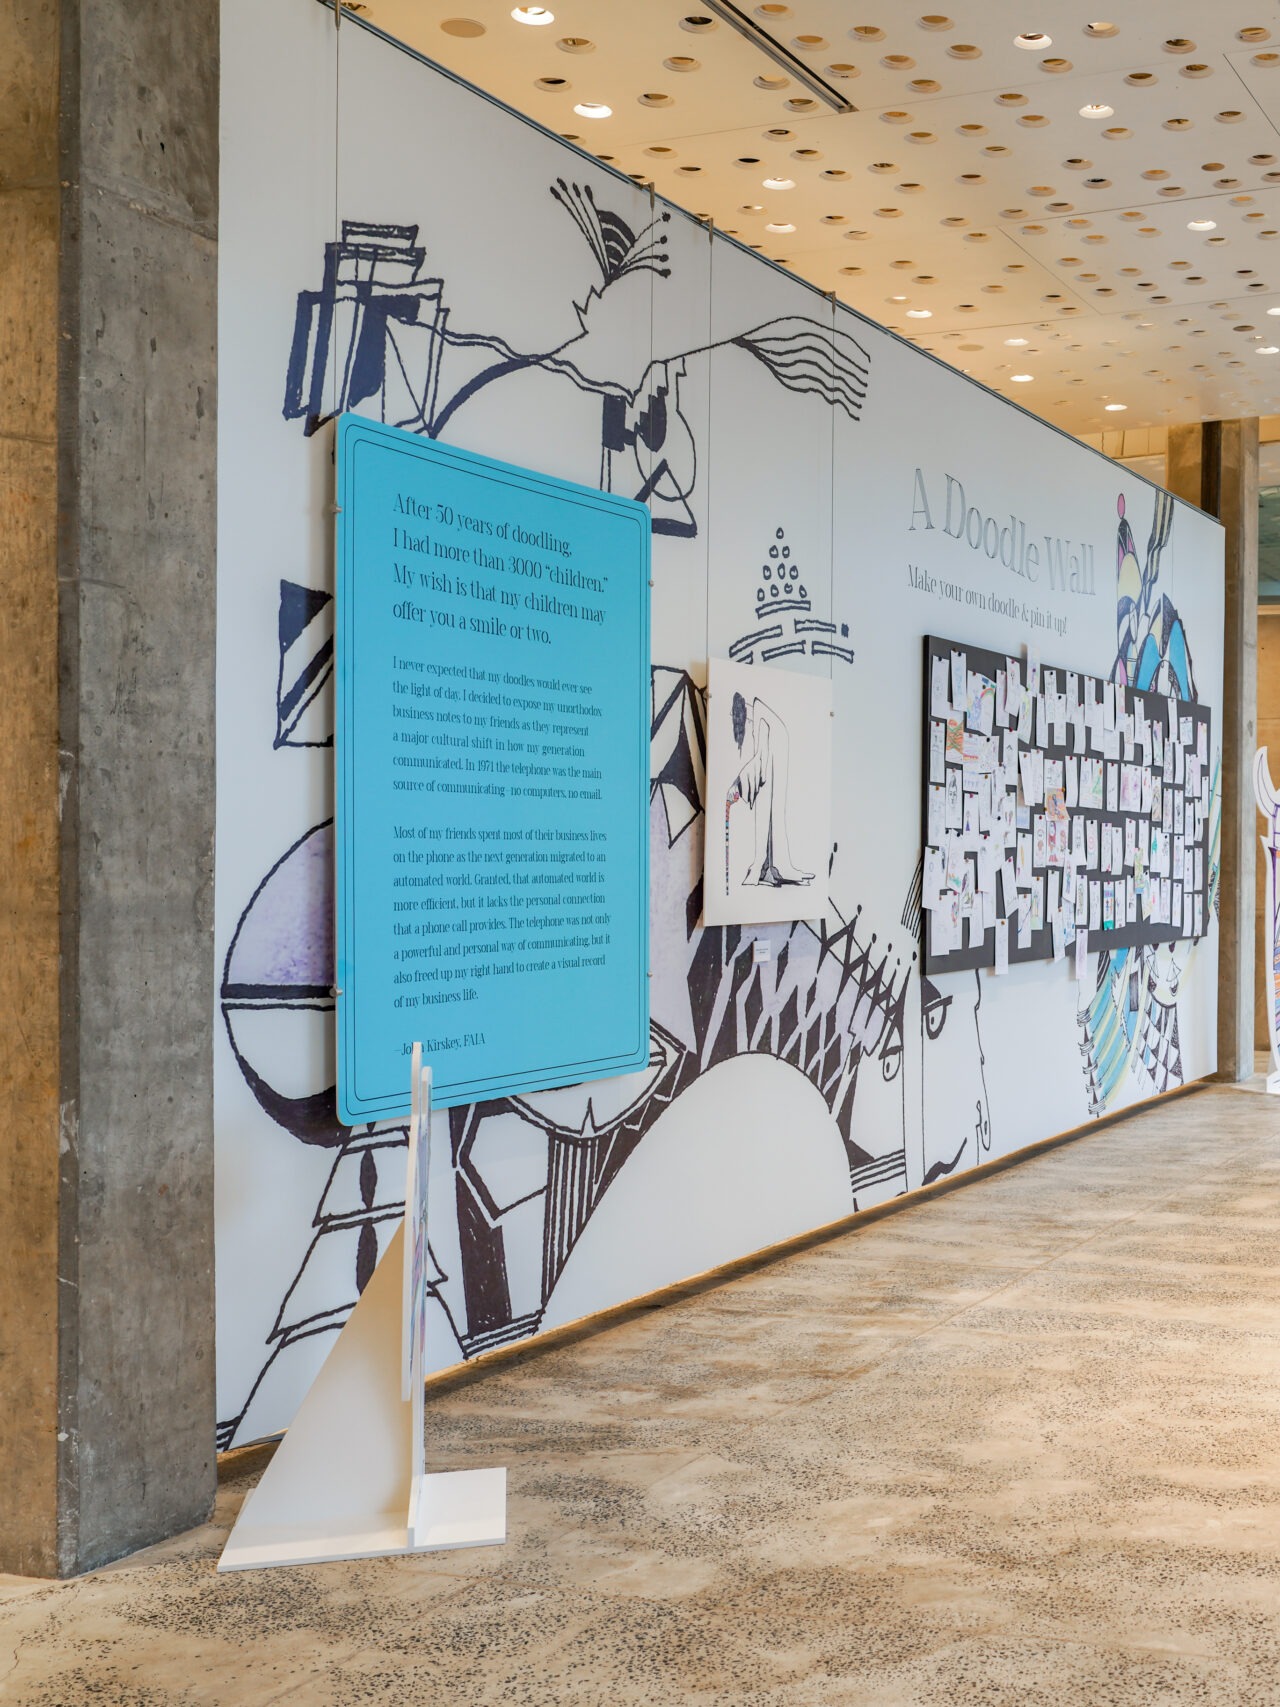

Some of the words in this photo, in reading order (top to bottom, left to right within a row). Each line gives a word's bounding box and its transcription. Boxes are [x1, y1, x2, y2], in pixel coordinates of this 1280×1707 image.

[393, 493, 433, 520] After
[436, 504, 454, 526] 50
[457, 514, 493, 536] years
[496, 522, 511, 540] of
[512, 525, 572, 558] doodling,
[908, 468, 935, 531] A
[942, 473, 1040, 583] Doodle
[1043, 536, 1096, 596] Wall
[393, 527, 398, 548] I
[403, 529, 430, 555] had
[434, 542, 470, 563] more
[473, 548, 505, 572] than
[508, 556, 543, 579] 3000
[393, 562, 416, 589] My
[420, 571, 452, 594] wish
[456, 576, 468, 597] is
[470, 580, 497, 602] that
[501, 590, 521, 610] my
[524, 592, 578, 618] children
[581, 606, 606, 626] may
[908, 564, 937, 594] Make
[939, 579, 964, 603] your
[965, 589, 986, 610] own
[988, 592, 1020, 619] doodle
[1021, 602, 1029, 623] &
[1030, 607, 1045, 629] pin
[1046, 610, 1052, 630] it
[1054, 616, 1067, 637] up!
[393, 600, 427, 623] offer
[429, 610, 455, 628] you
[459, 615, 466, 630] a
[469, 617, 507, 637] smile
[510, 625, 524, 640] or
[526, 624, 552, 644] two.
[399, 660, 425, 672] never
[426, 664, 468, 678] expected
[469, 667, 486, 681] that
[488, 672, 501, 685] my
[503, 672, 535, 687] doodles
[536, 679, 561, 691] would
[561, 683, 578, 693] ever
[579, 685, 593, 695] see
[392, 680, 409, 694] the
[410, 682, 431, 698] light
[433, 686, 444, 699] of
[444, 687, 461, 703] day.
[468, 690, 501, 705] decided
[502, 695, 512, 707] to
[512, 698, 542, 711] expose
[543, 701, 555, 714] my
[557, 703, 602, 717] unorthodox
[392, 704, 435, 721] business
[436, 712, 461, 724] notes
[462, 712, 473, 725] to
[474, 716, 488, 729] my
[490, 715, 520, 730] friends
[521, 721, 531, 731] as
[532, 720, 550, 735] they
[552, 724, 589, 737] represent
[392, 732, 399, 742] a
[401, 731, 429, 746] major
[431, 733, 469, 748] cultural
[471, 736, 493, 750] shift
[495, 738, 505, 751] in
[507, 739, 524, 752] how
[527, 743, 540, 756] my
[542, 745, 585, 757] generation
[392, 756, 464, 770] communicated.
[465, 758, 475, 772] In
[478, 759, 494, 773] 1971
[496, 760, 511, 773] the
[511, 762, 551, 777] telephone
[552, 767, 567, 777] was
[567, 766, 581, 778] the
[582, 768, 602, 779] main
[393, 826, 416, 839] Most
[417, 826, 428, 839] of
[429, 829, 443, 841] my
[445, 827, 477, 840] friends
[478, 829, 501, 843] spent
[503, 829, 523, 841] most
[525, 829, 534, 841] of
[534, 829, 555, 841] their
[555, 829, 589, 841] business
[590, 830, 607, 842] lives
[393, 853, 406, 863] on
[408, 850, 424, 863] the
[426, 850, 455, 866] phone
[456, 853, 466, 863] as
[467, 850, 483, 863] the
[484, 851, 503, 863] next
[505, 851, 549, 865] generation
[550, 851, 586, 864] migrated
[586, 852, 595, 862] to
[596, 853, 606, 862] an
[393, 874, 444, 887] automated
[446, 873, 473, 886] world.
[474, 873, 511, 886] Granted,
[512, 873, 529, 885] that
[531, 872, 574, 884] automated
[575, 871, 597, 883] world
[598, 871, 605, 883] is
[393, 901, 419, 912] more
[420, 897, 459, 910] efficient,
[460, 896, 476, 909] but
[486, 895, 509, 908] lacks
[509, 895, 524, 907] the
[525, 894, 561, 909] personal
[562, 893, 606, 905] connection
[393, 922, 412, 936] that
[414, 925, 420, 935] a
[422, 921, 451, 937] phone
[451, 919, 468, 932] call
[469, 918, 507, 934] provides.
[509, 917, 525, 929] The
[526, 916, 565, 930] telephone
[566, 917, 580, 926] was
[581, 914, 593, 925] not
[595, 912, 611, 926] only
[393, 950, 399, 960] a
[401, 944, 442, 962] powerful
[443, 943, 461, 956] and
[463, 940, 499, 957] personal
[501, 942, 516, 953] way
[517, 939, 526, 951] of
[527, 936, 590, 950] communicating,
[591, 934, 604, 945] but
[393, 971, 413, 984] also
[414, 968, 439, 983] freed
[440, 969, 453, 982] up
[454, 968, 469, 980] my
[470, 964, 491, 979] right
[493, 961, 515, 975] hand
[516, 962, 525, 973] to
[526, 960, 550, 972] create
[551, 961, 556, 970] a
[557, 956, 581, 969] visual
[581, 954, 606, 967] record
[393, 995, 405, 1009] of
[405, 996, 420, 1009] my
[422, 992, 461, 1005] business
[463, 988, 479, 1001] life.
[393, 1043, 425, 1056] —Jon
[427, 1037, 462, 1050] Kirskey,
[463, 1033, 486, 1047] FAIA
